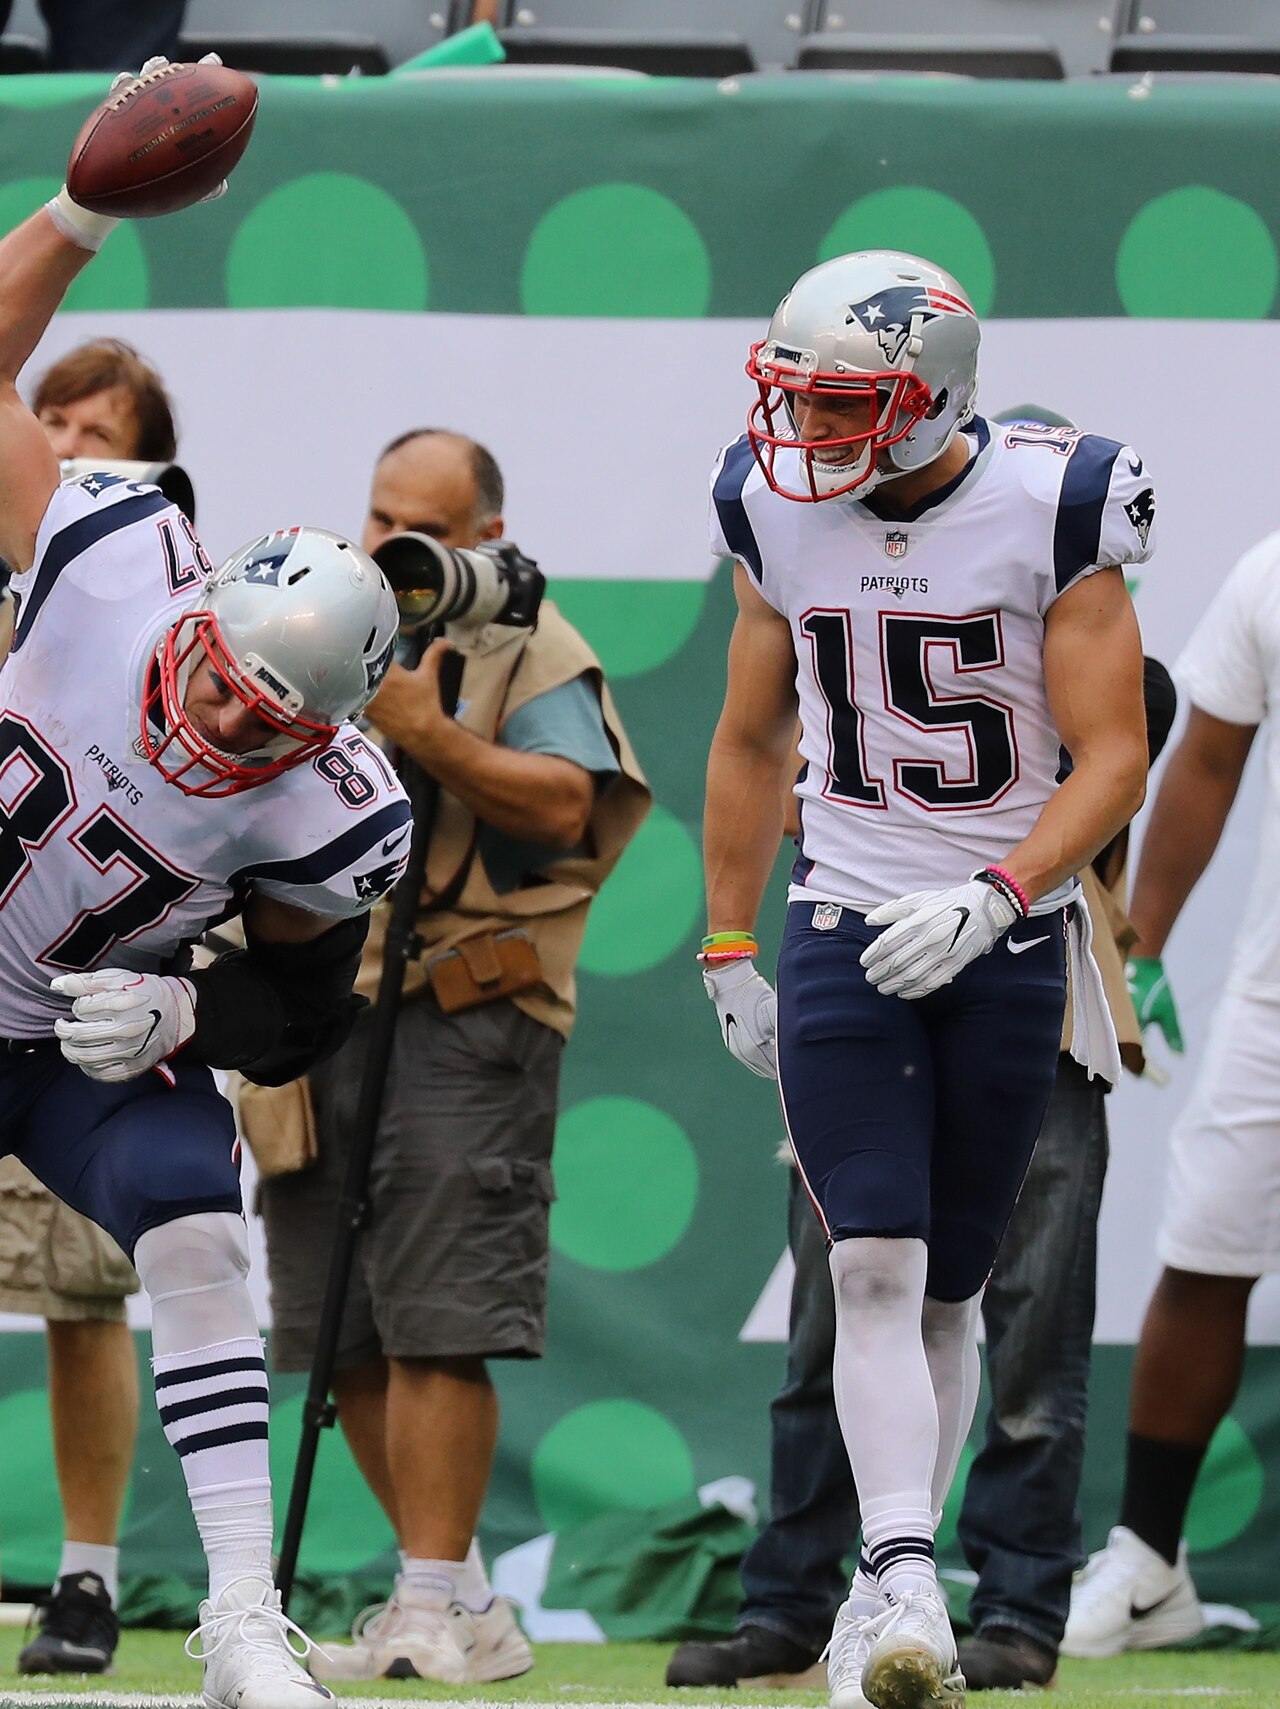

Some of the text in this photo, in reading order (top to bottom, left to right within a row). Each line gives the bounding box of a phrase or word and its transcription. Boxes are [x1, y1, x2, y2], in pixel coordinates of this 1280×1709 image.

[887, 542, 904, 554] NFL
[860, 576, 929, 594] PATRIOTS
[799, 606, 1020, 813] 15
[85, 744, 143, 806] PATRIOTS
[312, 733, 398, 810] 87
